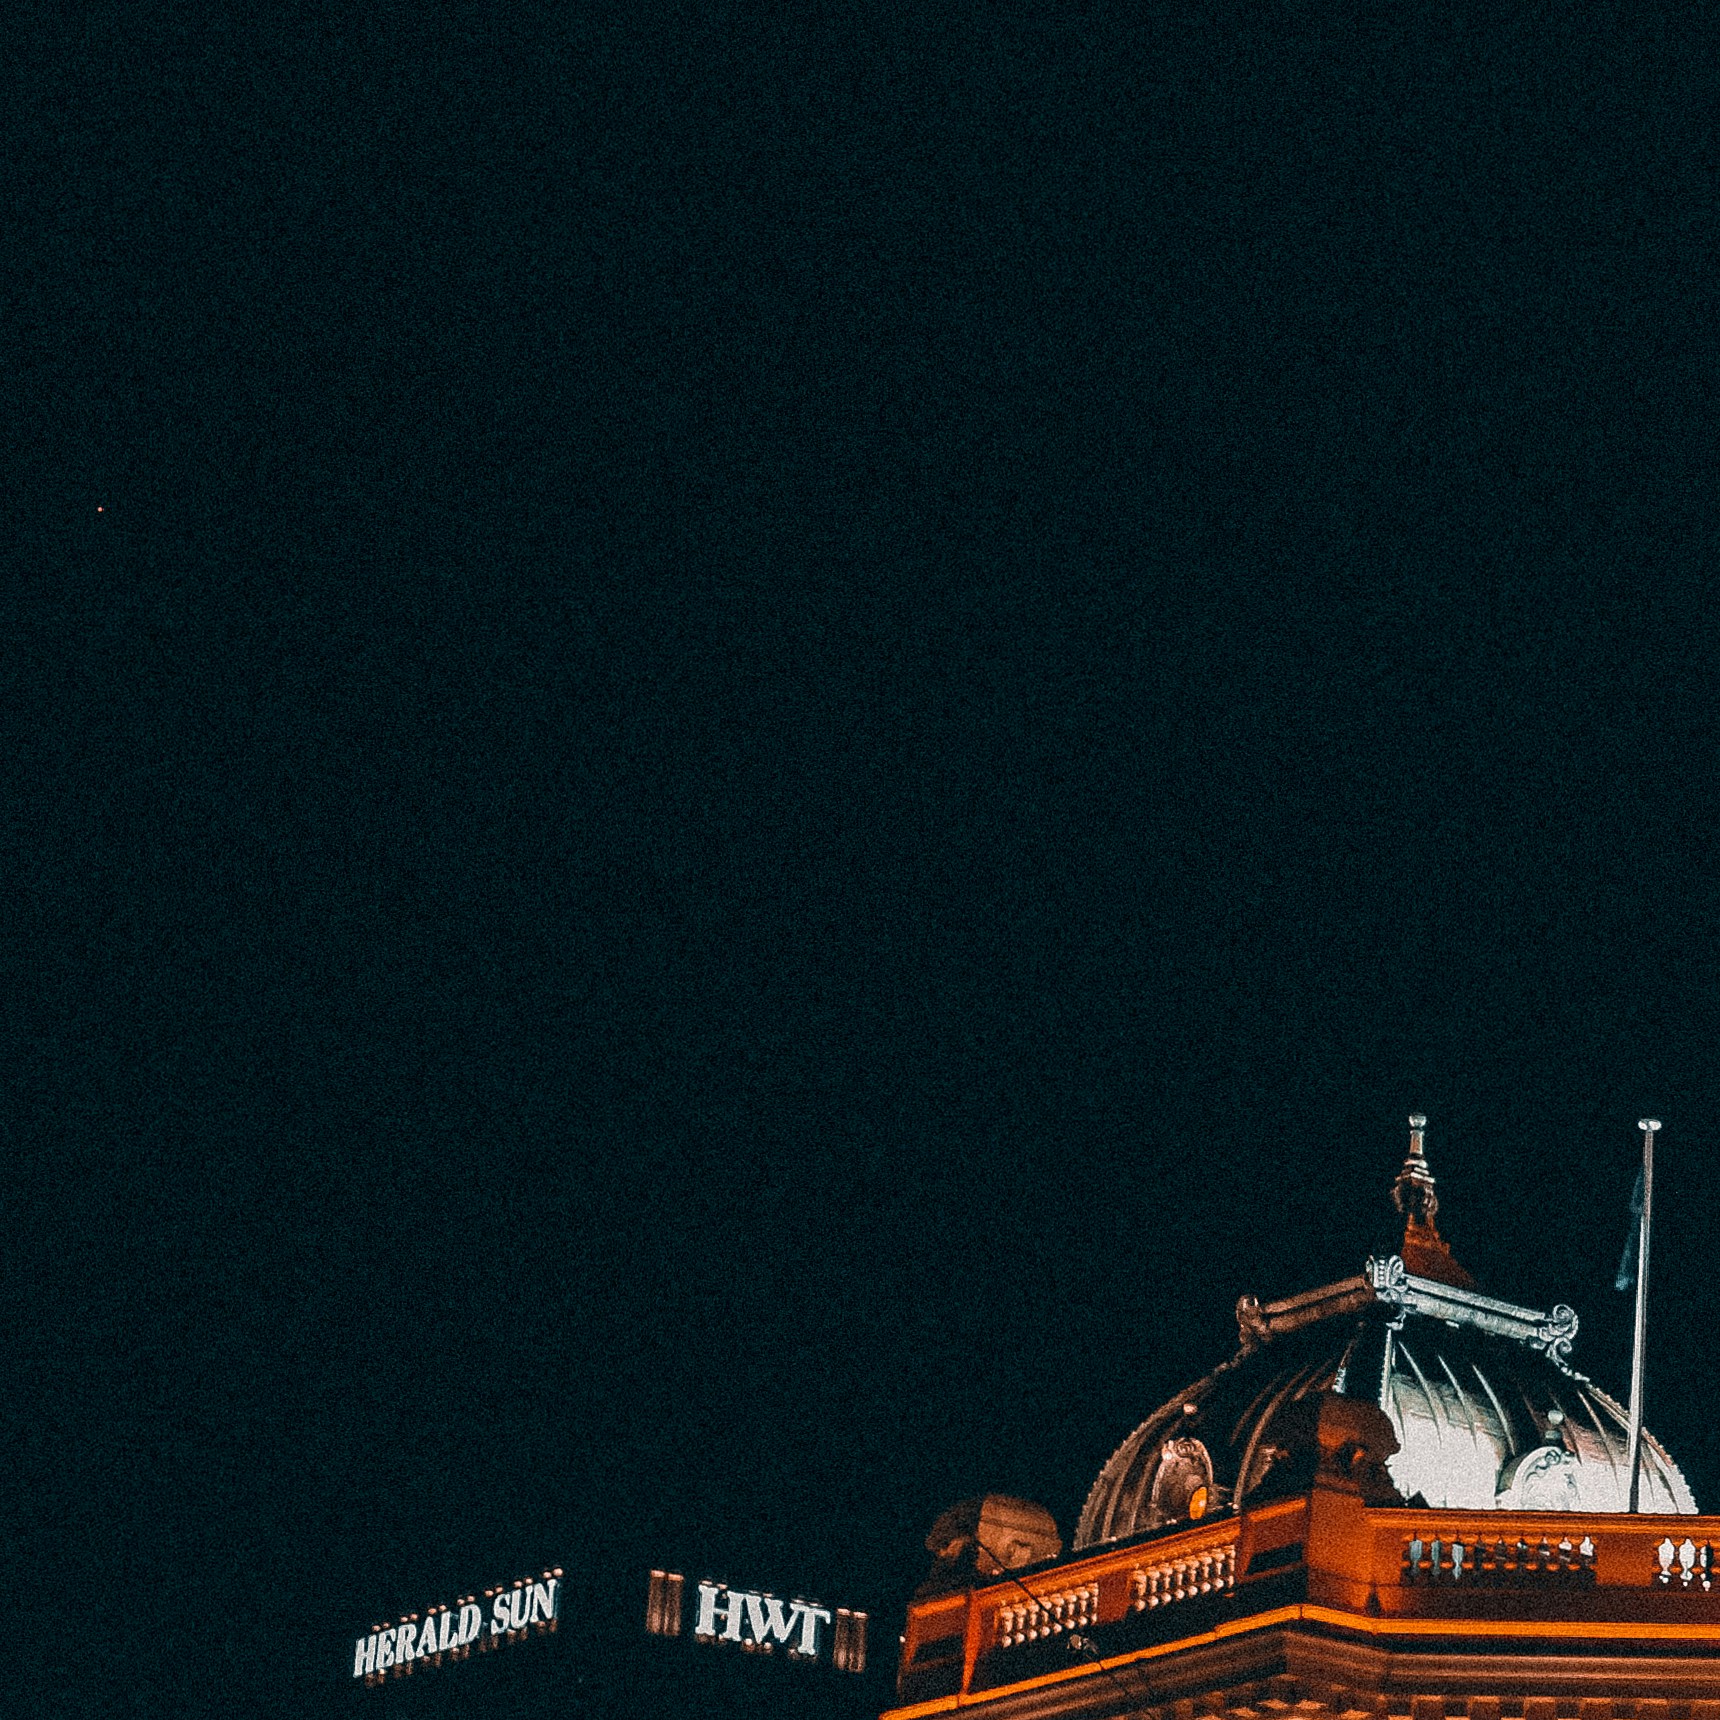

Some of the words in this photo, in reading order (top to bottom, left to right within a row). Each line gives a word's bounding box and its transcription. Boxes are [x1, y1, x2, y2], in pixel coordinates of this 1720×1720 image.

[352, 1603, 483, 1680] HERALD
[490, 1578, 558, 1636] SUN
[694, 1584, 832, 1656] HWT
